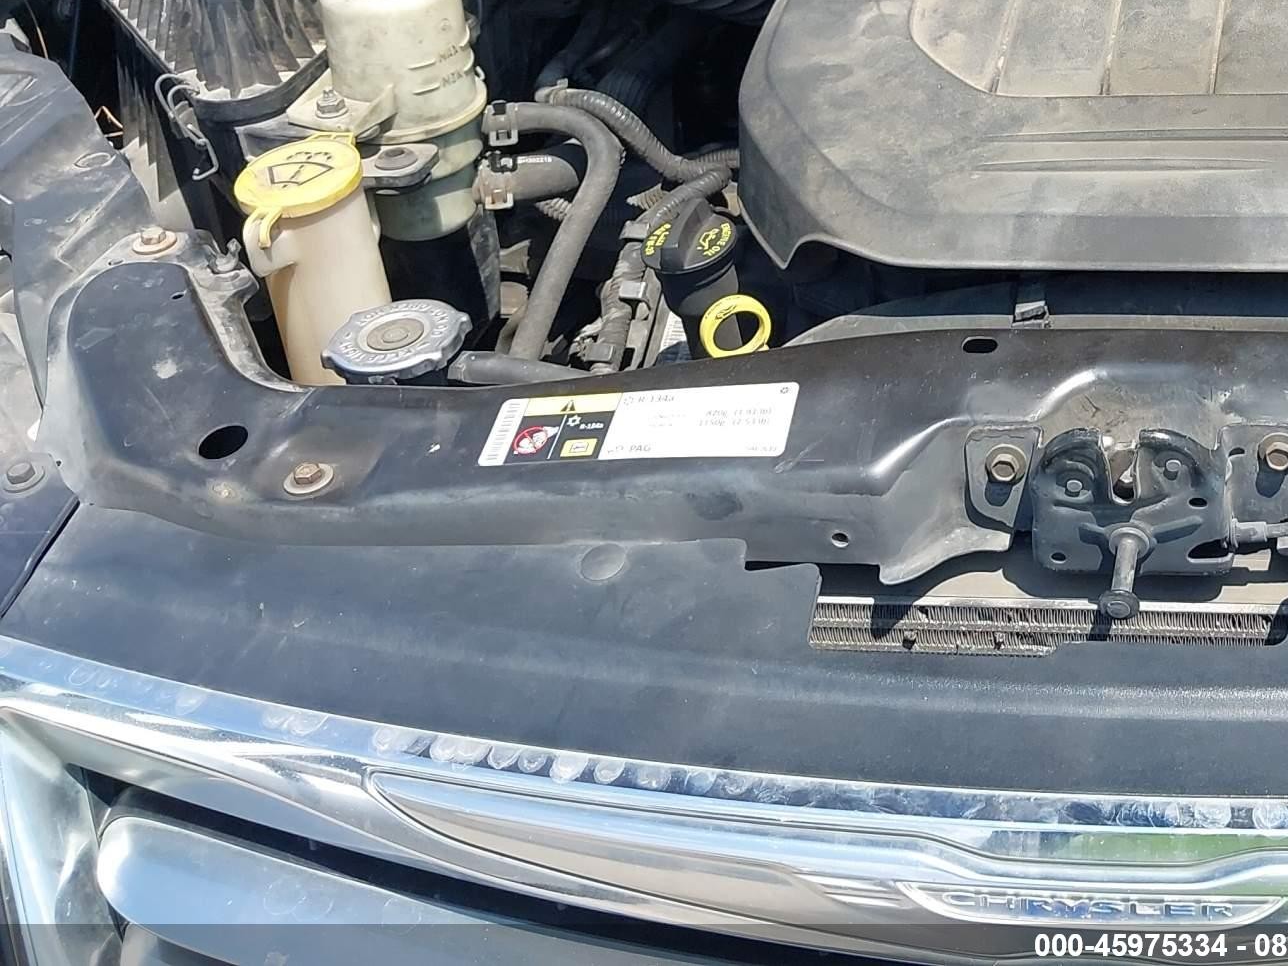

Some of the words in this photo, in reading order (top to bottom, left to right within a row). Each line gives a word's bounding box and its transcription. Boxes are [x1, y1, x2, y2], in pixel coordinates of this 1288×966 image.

[720, 222, 733, 247] ENGINE
[703, 246, 721, 257] OIL
[942, 891, 1233, 919] CHRYSLER
